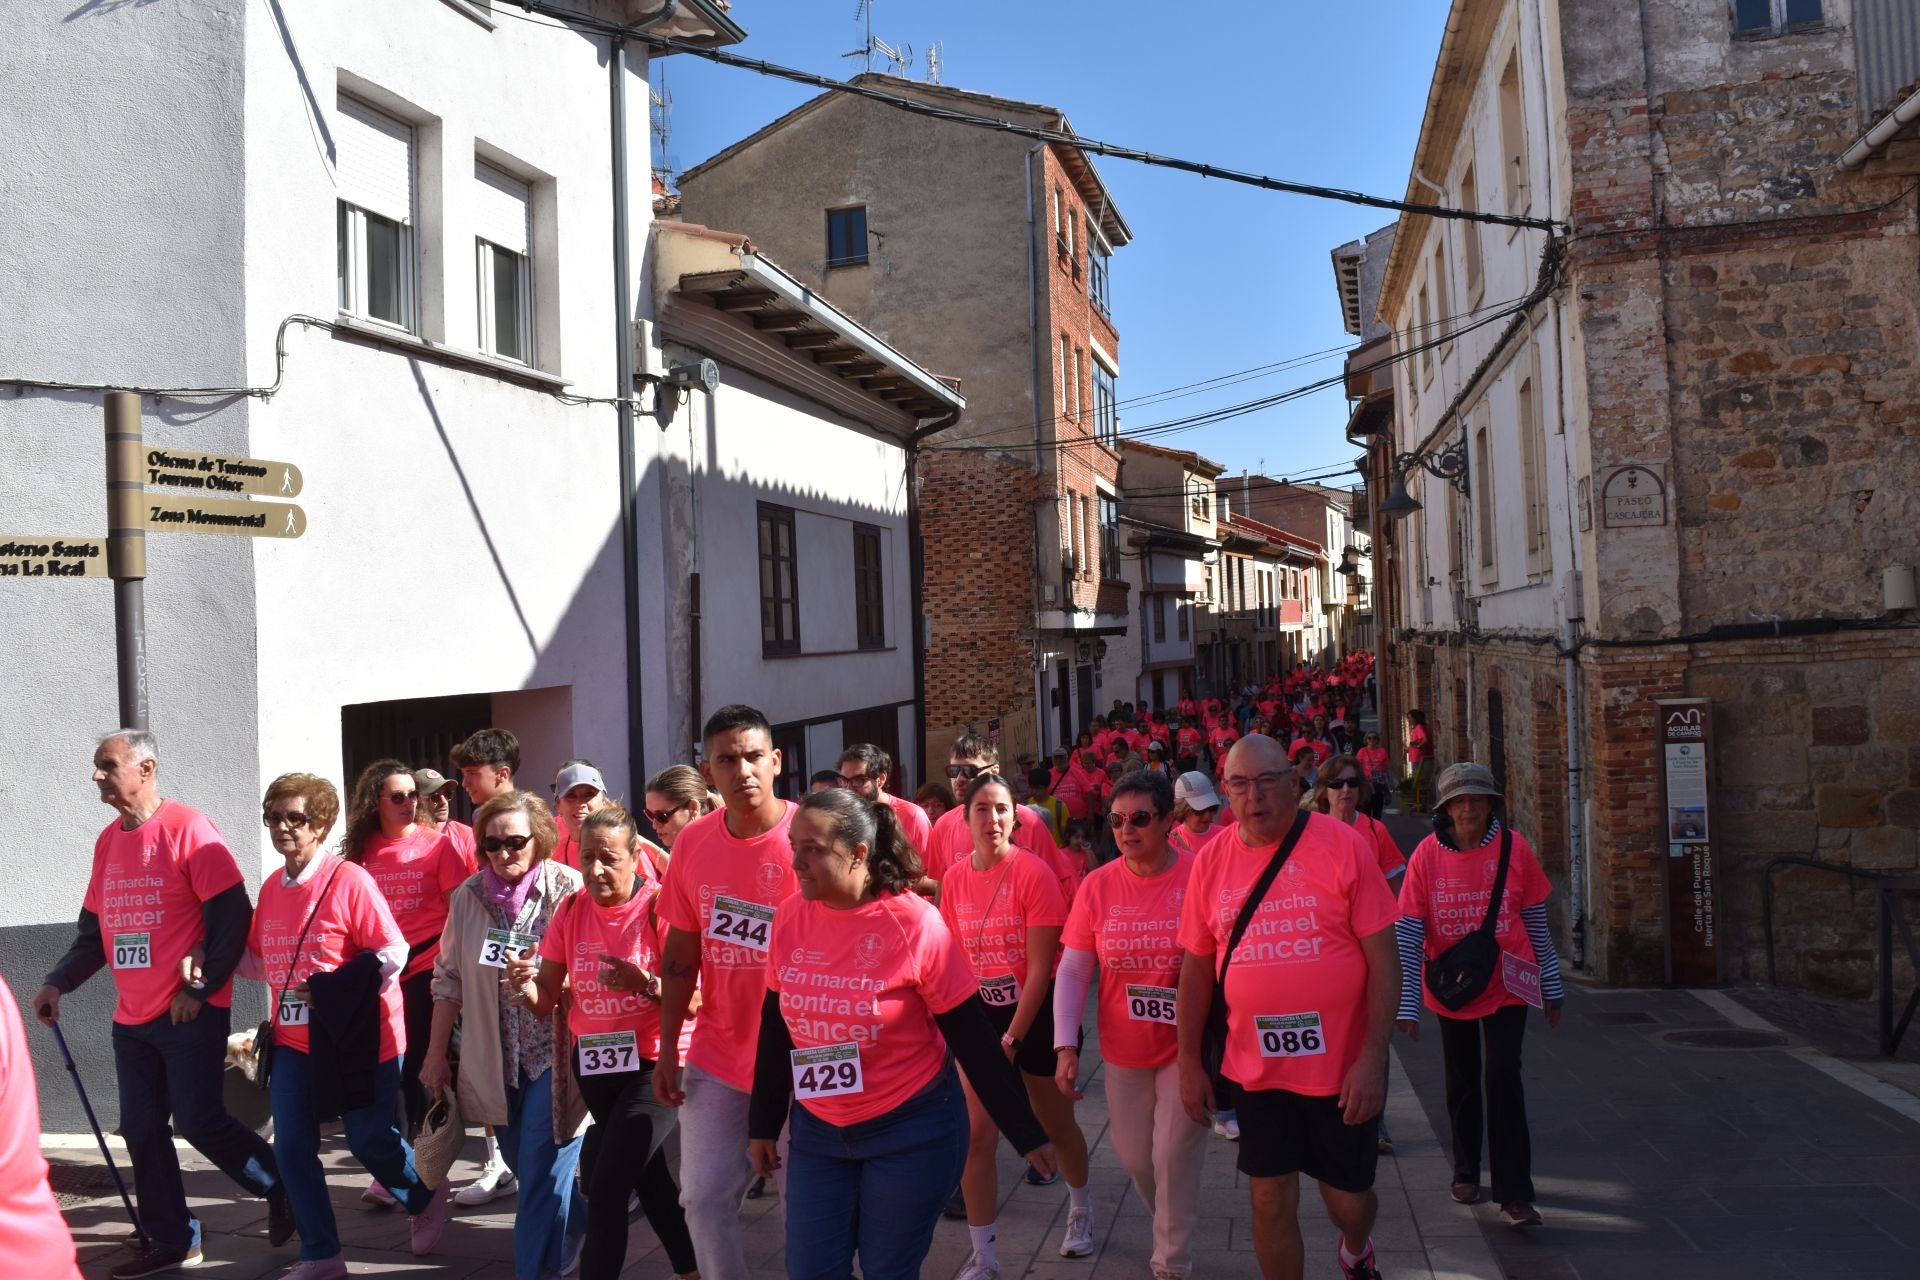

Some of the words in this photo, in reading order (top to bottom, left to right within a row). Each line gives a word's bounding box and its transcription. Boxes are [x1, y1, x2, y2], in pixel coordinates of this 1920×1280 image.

[148, 451, 196, 470] Oficina
[198, 456, 214, 472] de
[215, 458, 267, 477] Turismo
[205, 475, 244, 492] Office
[1617, 497, 1652, 506] PASEO
[150, 506, 185, 523] Zona
[186, 509, 266, 528] Monumental
[1607, 510, 1661, 520] CASCAJERA
[52, 541, 99, 557] Santa
[21, 559, 44, 576] La
[46, 559, 86, 576] Real
[1693, 845, 1702, 853] y
[1702, 845, 1712, 877] Roque
[375, 869, 424, 881] marcha
[1693, 853, 1702, 889] Puente
[105, 878, 116, 890] En
[117, 875, 164, 889] marcha
[407, 882, 423, 894] el
[1703, 880, 1711, 898] San
[104, 892, 144, 908] contra
[144, 891, 163, 905] el
[1437, 891, 1454, 903] En
[1457, 888, 1510, 902] marca
[1694, 891, 1702, 906] del
[1703, 899, 1712, 911] de
[104, 908, 166, 928] cáncer
[969, 913, 1023, 930] marcha
[1108, 919, 1127, 931] En
[1132, 917, 1181, 931] marc
[1296, 911, 1320, 931] el
[1694, 909, 1703, 932] Calle
[713, 913, 768, 946] 244
[1006, 928, 1024, 943] el
[1441, 919, 1512, 936] cáner
[1704, 914, 1713, 947] Puerta
[263, 934, 275, 947] En
[1105, 936, 1172, 951] contra
[1230, 935, 1323, 963] cáncer
[116, 946, 148, 965] 078
[485, 943, 529, 965] 35
[710, 942, 768, 965] cánc
[1106, 952, 1184, 970] cánce
[575, 957, 594, 972] En
[783, 967, 807, 985] En
[810, 973, 885, 992] marcha
[1520, 971, 1537, 986] 470
[980, 984, 1016, 1002] 087
[280, 1003, 308, 1022] 07
[581, 994, 652, 1015] cánce
[781, 991, 851, 1016] contra
[855, 995, 882, 1017] el
[1131, 998, 1176, 1021] 085
[784, 1013, 884, 1041] cáncer
[1263, 1029, 1321, 1053] 086
[584, 1046, 634, 1071] 337
[799, 1062, 857, 1092] 429
